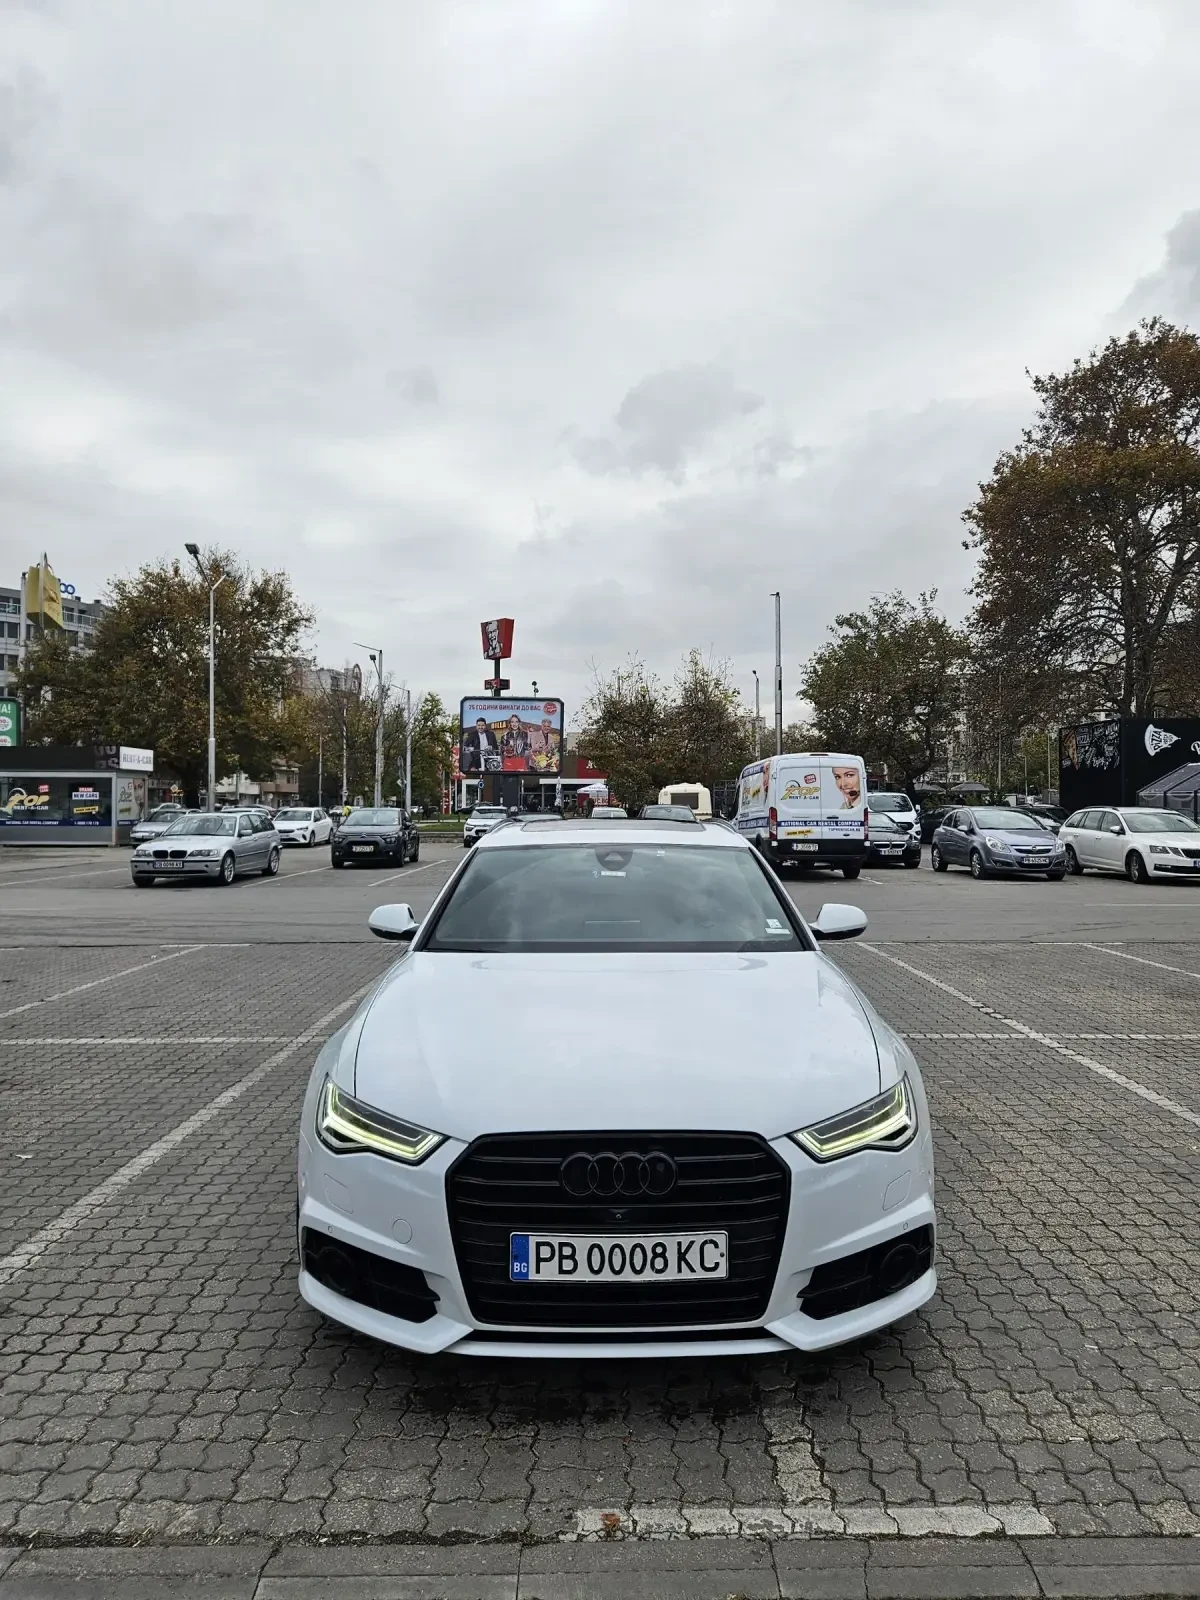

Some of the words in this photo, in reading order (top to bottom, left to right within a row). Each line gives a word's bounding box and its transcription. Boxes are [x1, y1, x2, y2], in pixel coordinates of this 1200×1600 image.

[0, 703, 11, 714] А!
[122, 753, 153, 765] RENT-A-CAR
[781, 786, 820, 801] TOP
[7, 793, 50, 815] TOP
[535, 1241, 578, 1275] PB
[587, 1242, 668, 1275] 0008
[676, 1239, 720, 1274] KC
[513, 1262, 528, 1273] BG
